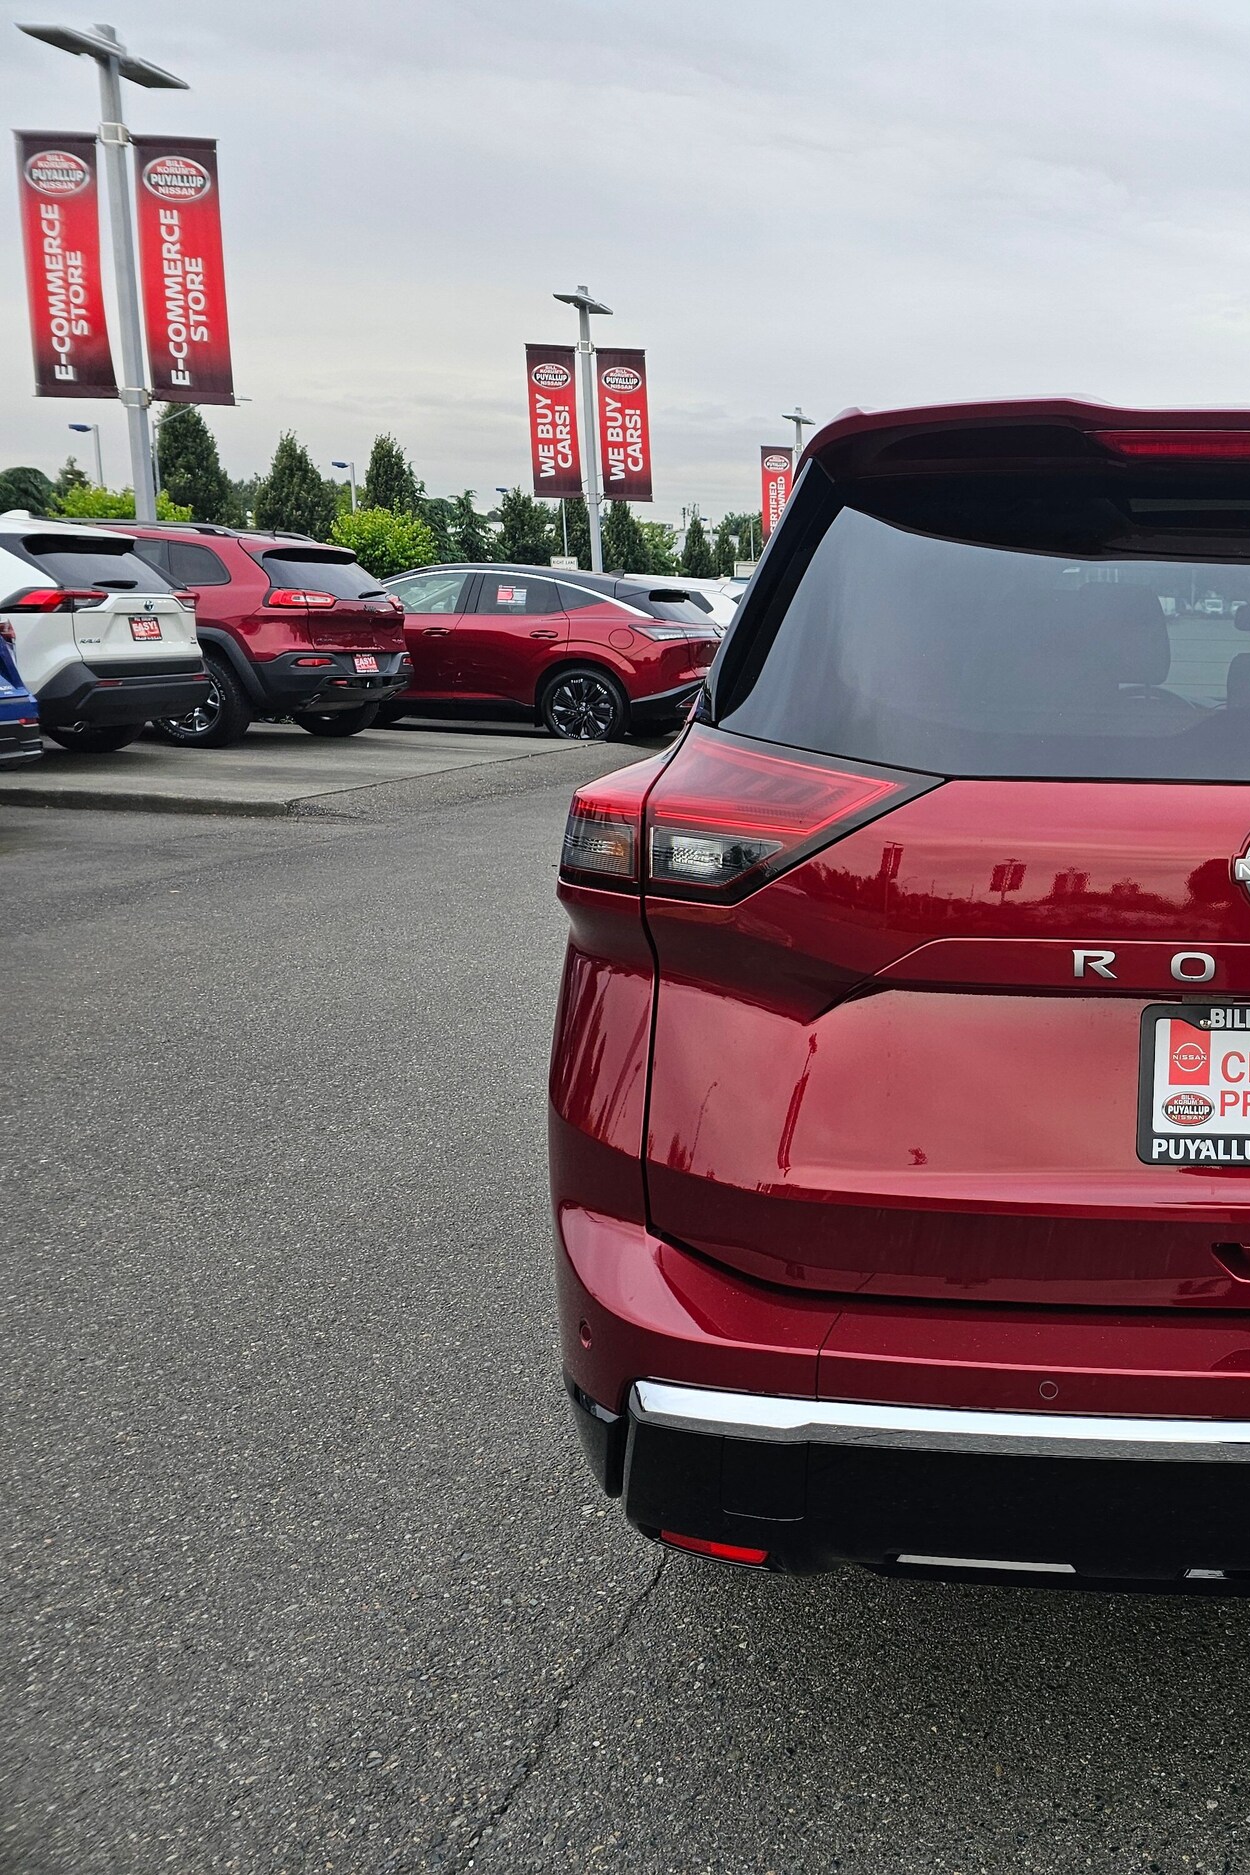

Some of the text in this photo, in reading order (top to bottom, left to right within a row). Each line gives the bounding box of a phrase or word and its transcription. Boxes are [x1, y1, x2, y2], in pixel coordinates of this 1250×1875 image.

[165, 159, 184, 168] BILL
[32, 168, 84, 182] PUYALLUP
[157, 166, 196, 176] KORUM'S
[39, 181, 76, 190] NISSAN
[150, 173, 204, 188] PUYALLUP
[158, 186, 196, 196] NISSAN
[40, 203, 75, 381] E-COMMERCE
[65, 250, 89, 337] STORE
[159, 208, 191, 386] E-COMMERCE
[184, 256, 208, 342] STORE
[536, 373, 568, 381] PUYALLUP
[605, 377, 638, 385] PUYALLUP
[535, 393, 556, 478] WE BUY
[554, 405, 573, 469] CARS!
[605, 397, 625, 481] WE BUY
[625, 409, 644, 472] CARS!
[1172, 1053, 1207, 1061] NISSAN
[1167, 1105, 1210, 1115] PUYALLUP
